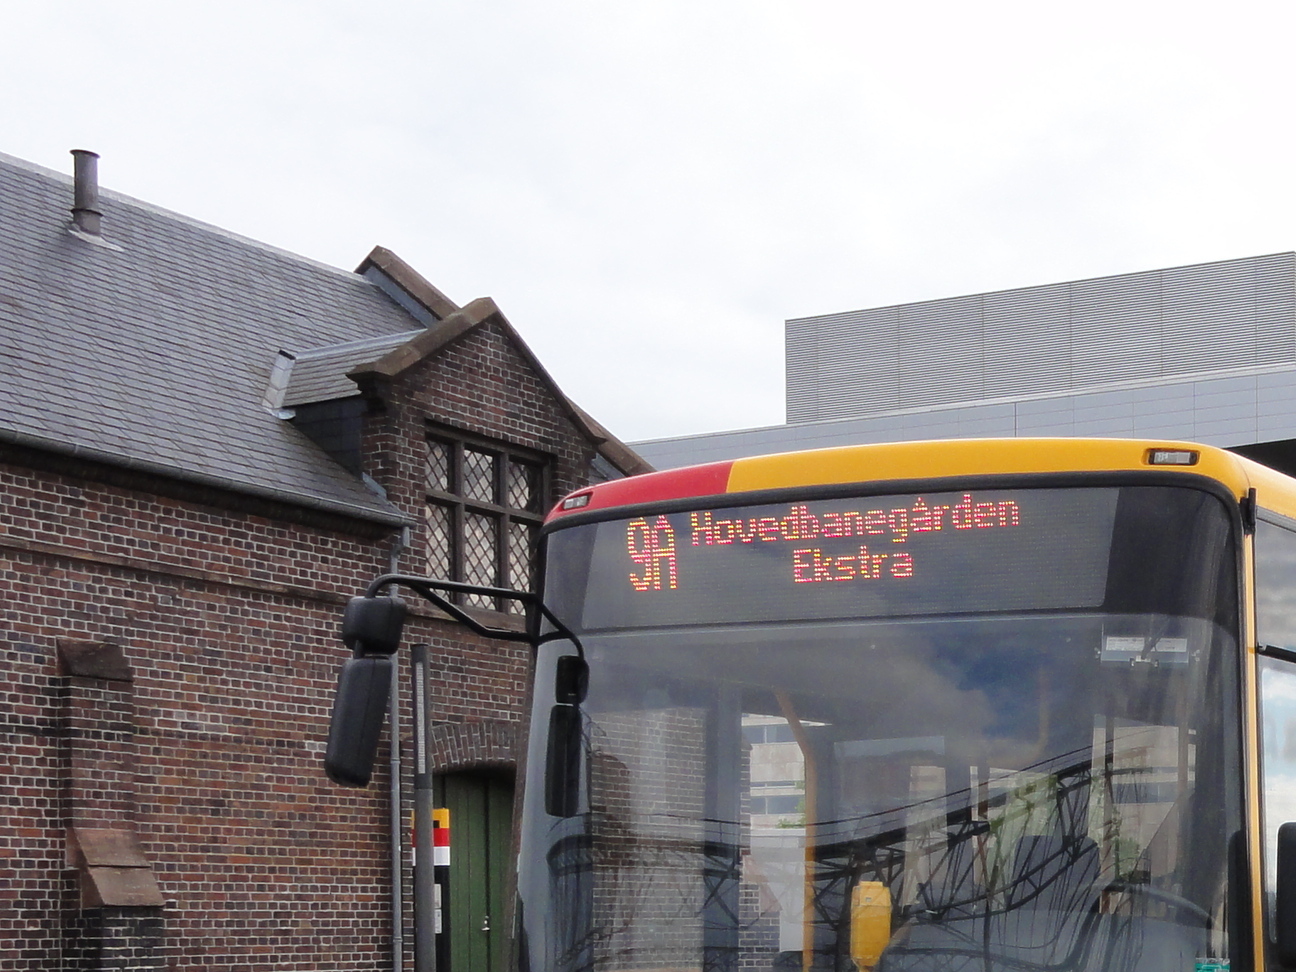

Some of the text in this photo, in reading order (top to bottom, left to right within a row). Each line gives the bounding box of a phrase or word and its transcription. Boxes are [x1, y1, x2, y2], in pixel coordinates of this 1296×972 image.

[627, 493, 1020, 591] 9A Hovedbanegården
[793, 545, 914, 582] Ekstra
